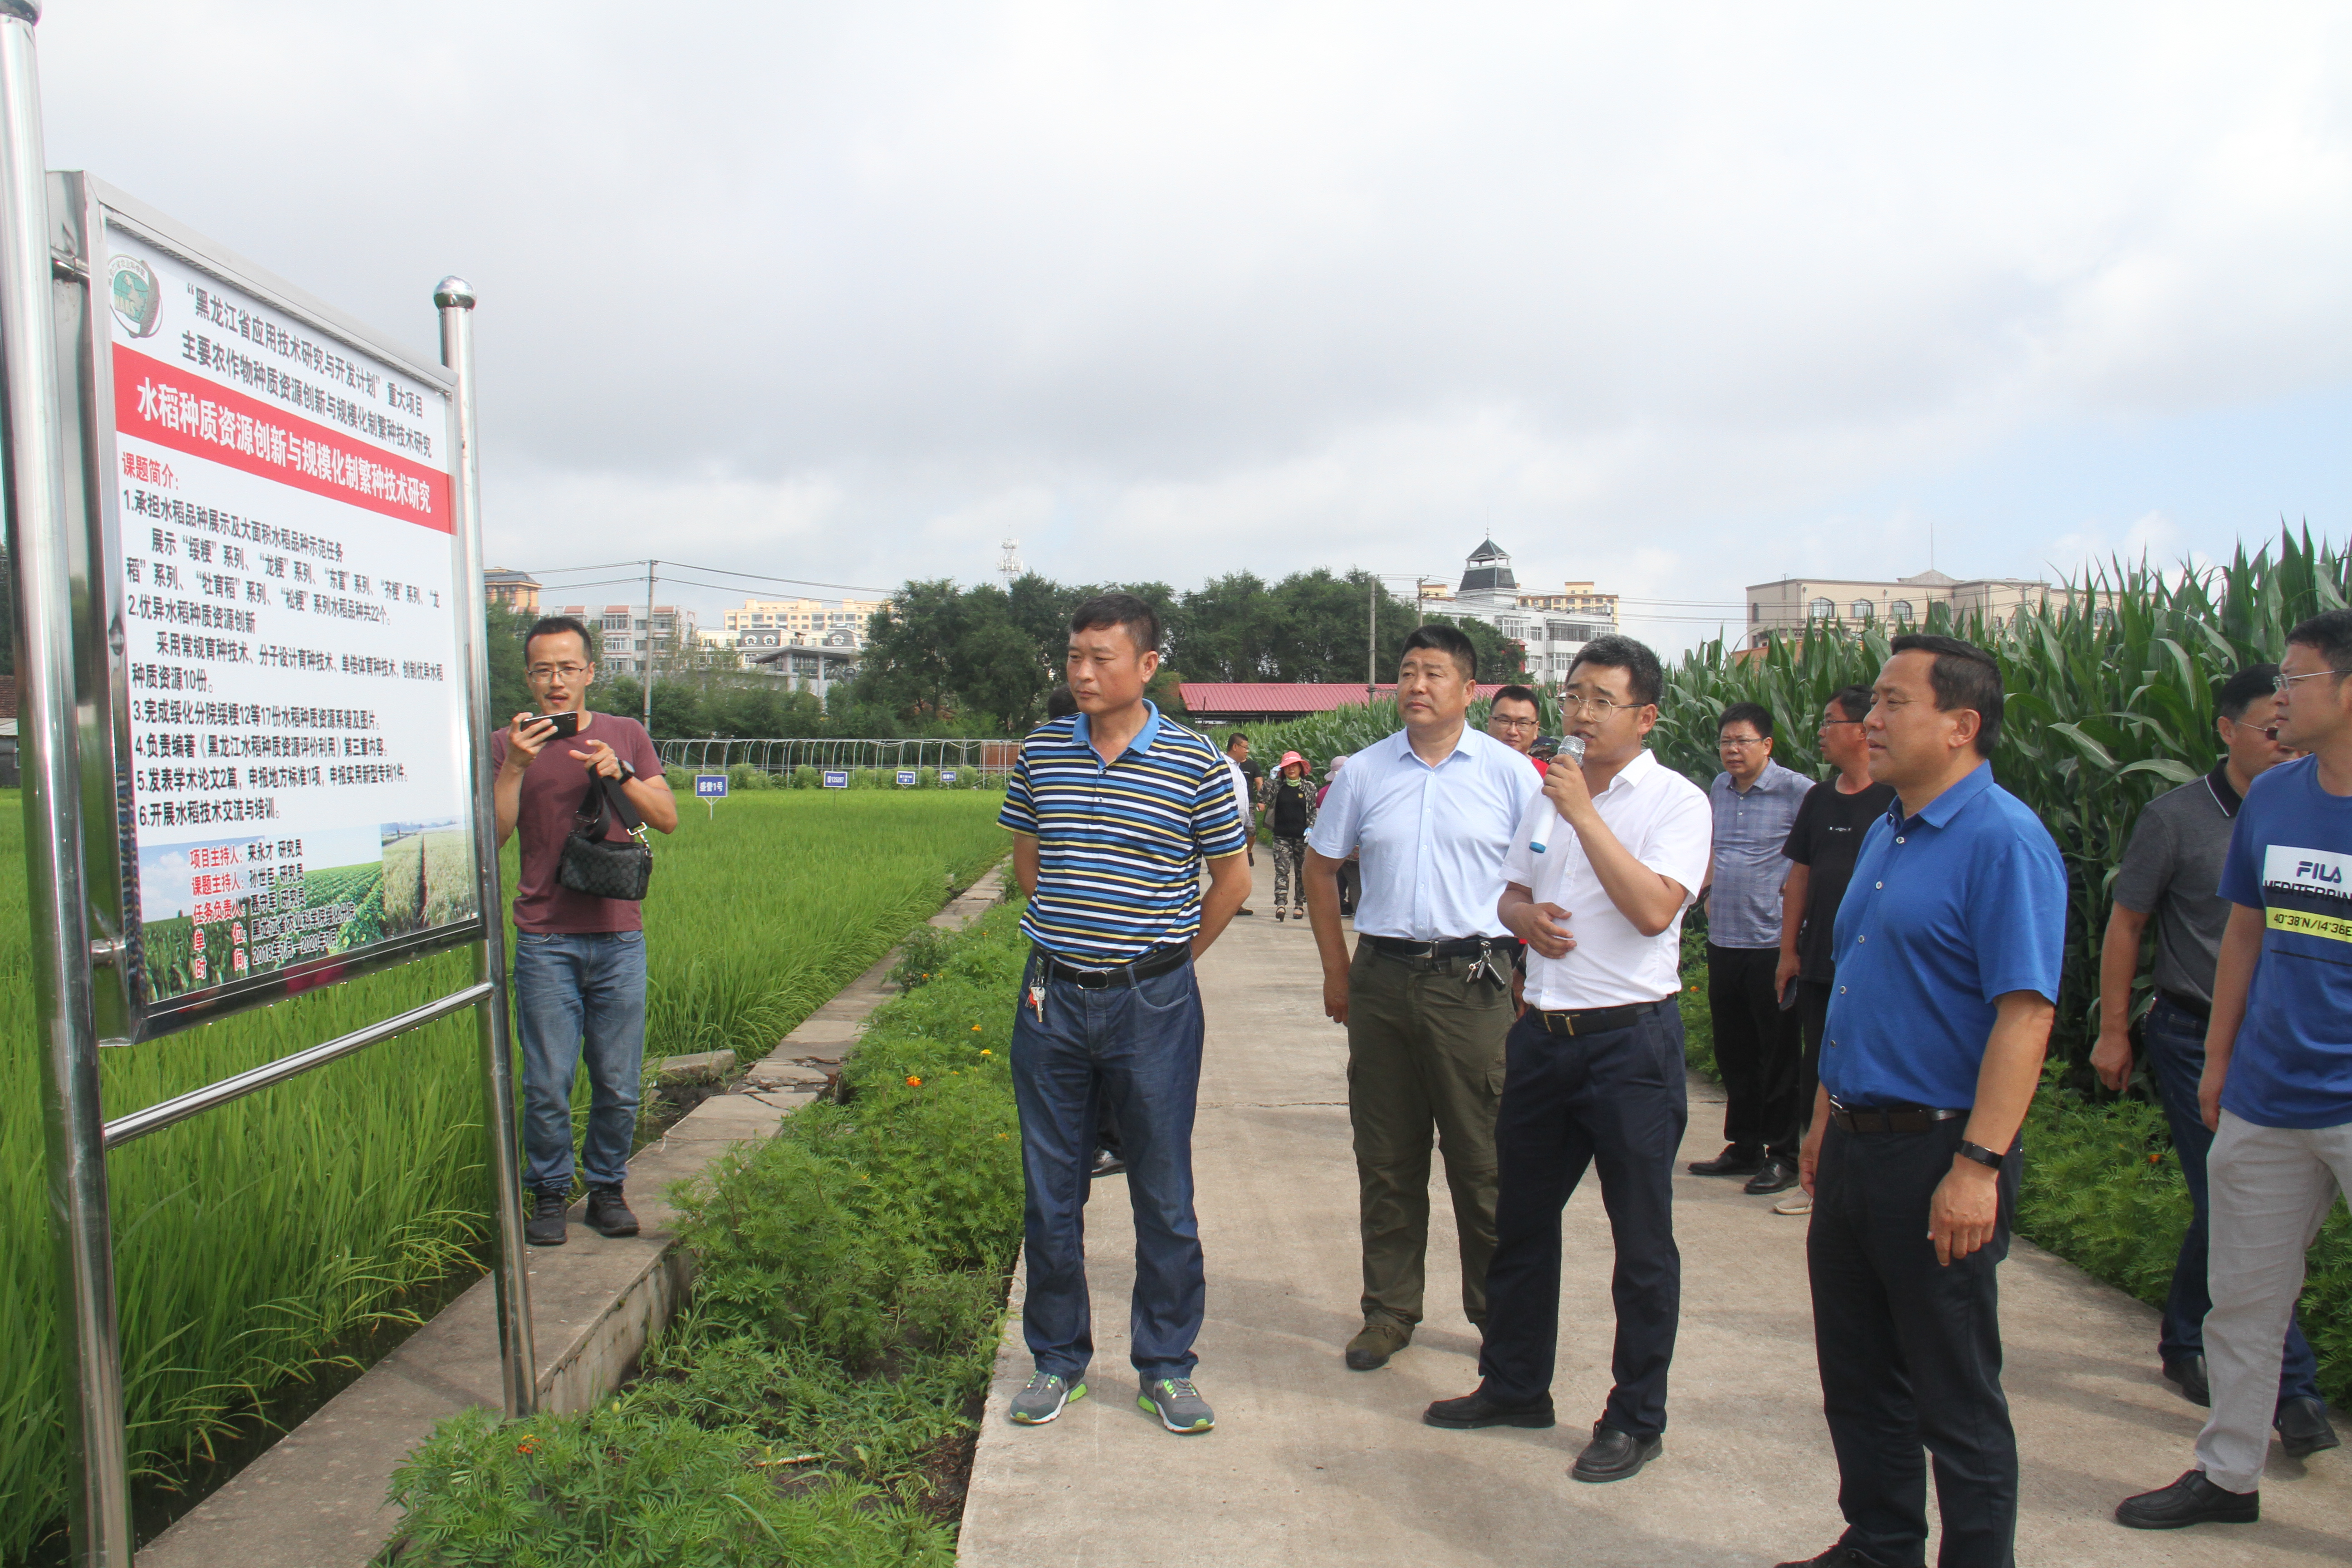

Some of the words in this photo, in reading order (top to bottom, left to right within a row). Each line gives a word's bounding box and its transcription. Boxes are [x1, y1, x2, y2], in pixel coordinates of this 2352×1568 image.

[182, 330, 432, 458] 主要农作物种质资源创新与规模化制繁种技术研究
[137, 377, 431, 514] 水稻种质资源创新与规模化制繁种技术研究
[122, 451, 179, 490] 课题简介：
[124, 489, 343, 563] 1.承担水稻品种展示及大面积水稻品种示范任务
[128, 593, 256, 634] 2.优异水稻种质资源创新
[132, 662, 213, 693] 种质资源10份。
[139, 797, 280, 828] 6.开展水稻技术交流与培训。
[278, 838, 304, 859] 研究员
[279, 863, 304, 885] 研究员
[2296, 861, 2342, 884] FILA
[280, 887, 306, 908] 研究员
